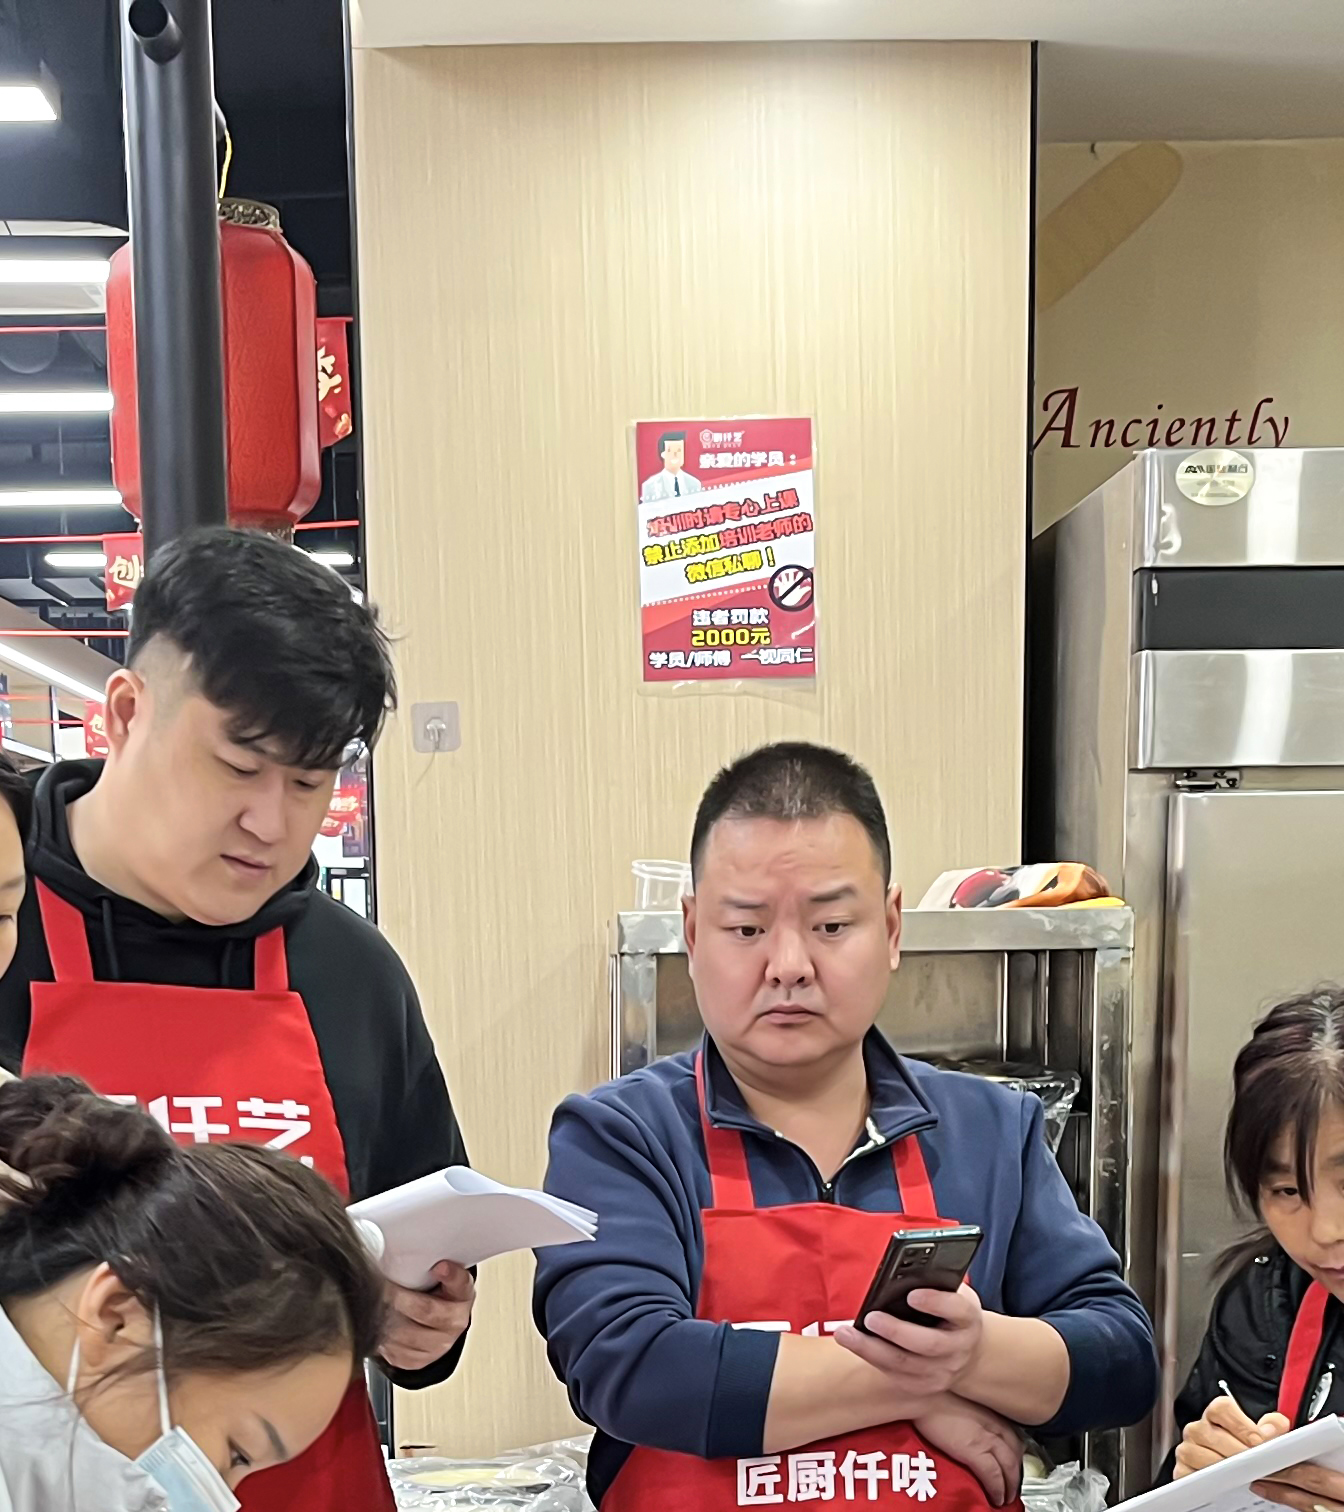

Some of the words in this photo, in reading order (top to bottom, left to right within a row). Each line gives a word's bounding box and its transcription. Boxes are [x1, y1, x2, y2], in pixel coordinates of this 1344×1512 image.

[1032, 386, 1291, 449] Anciently
[647, 488, 800, 537] 培训时请专心上课
[692, 607, 769, 626] 违者罚款
[691, 627, 771, 647] 2000元
[741, 648, 814, 665] 一视同仁
[737, 1450, 938, 1506] 匠厨仟味
